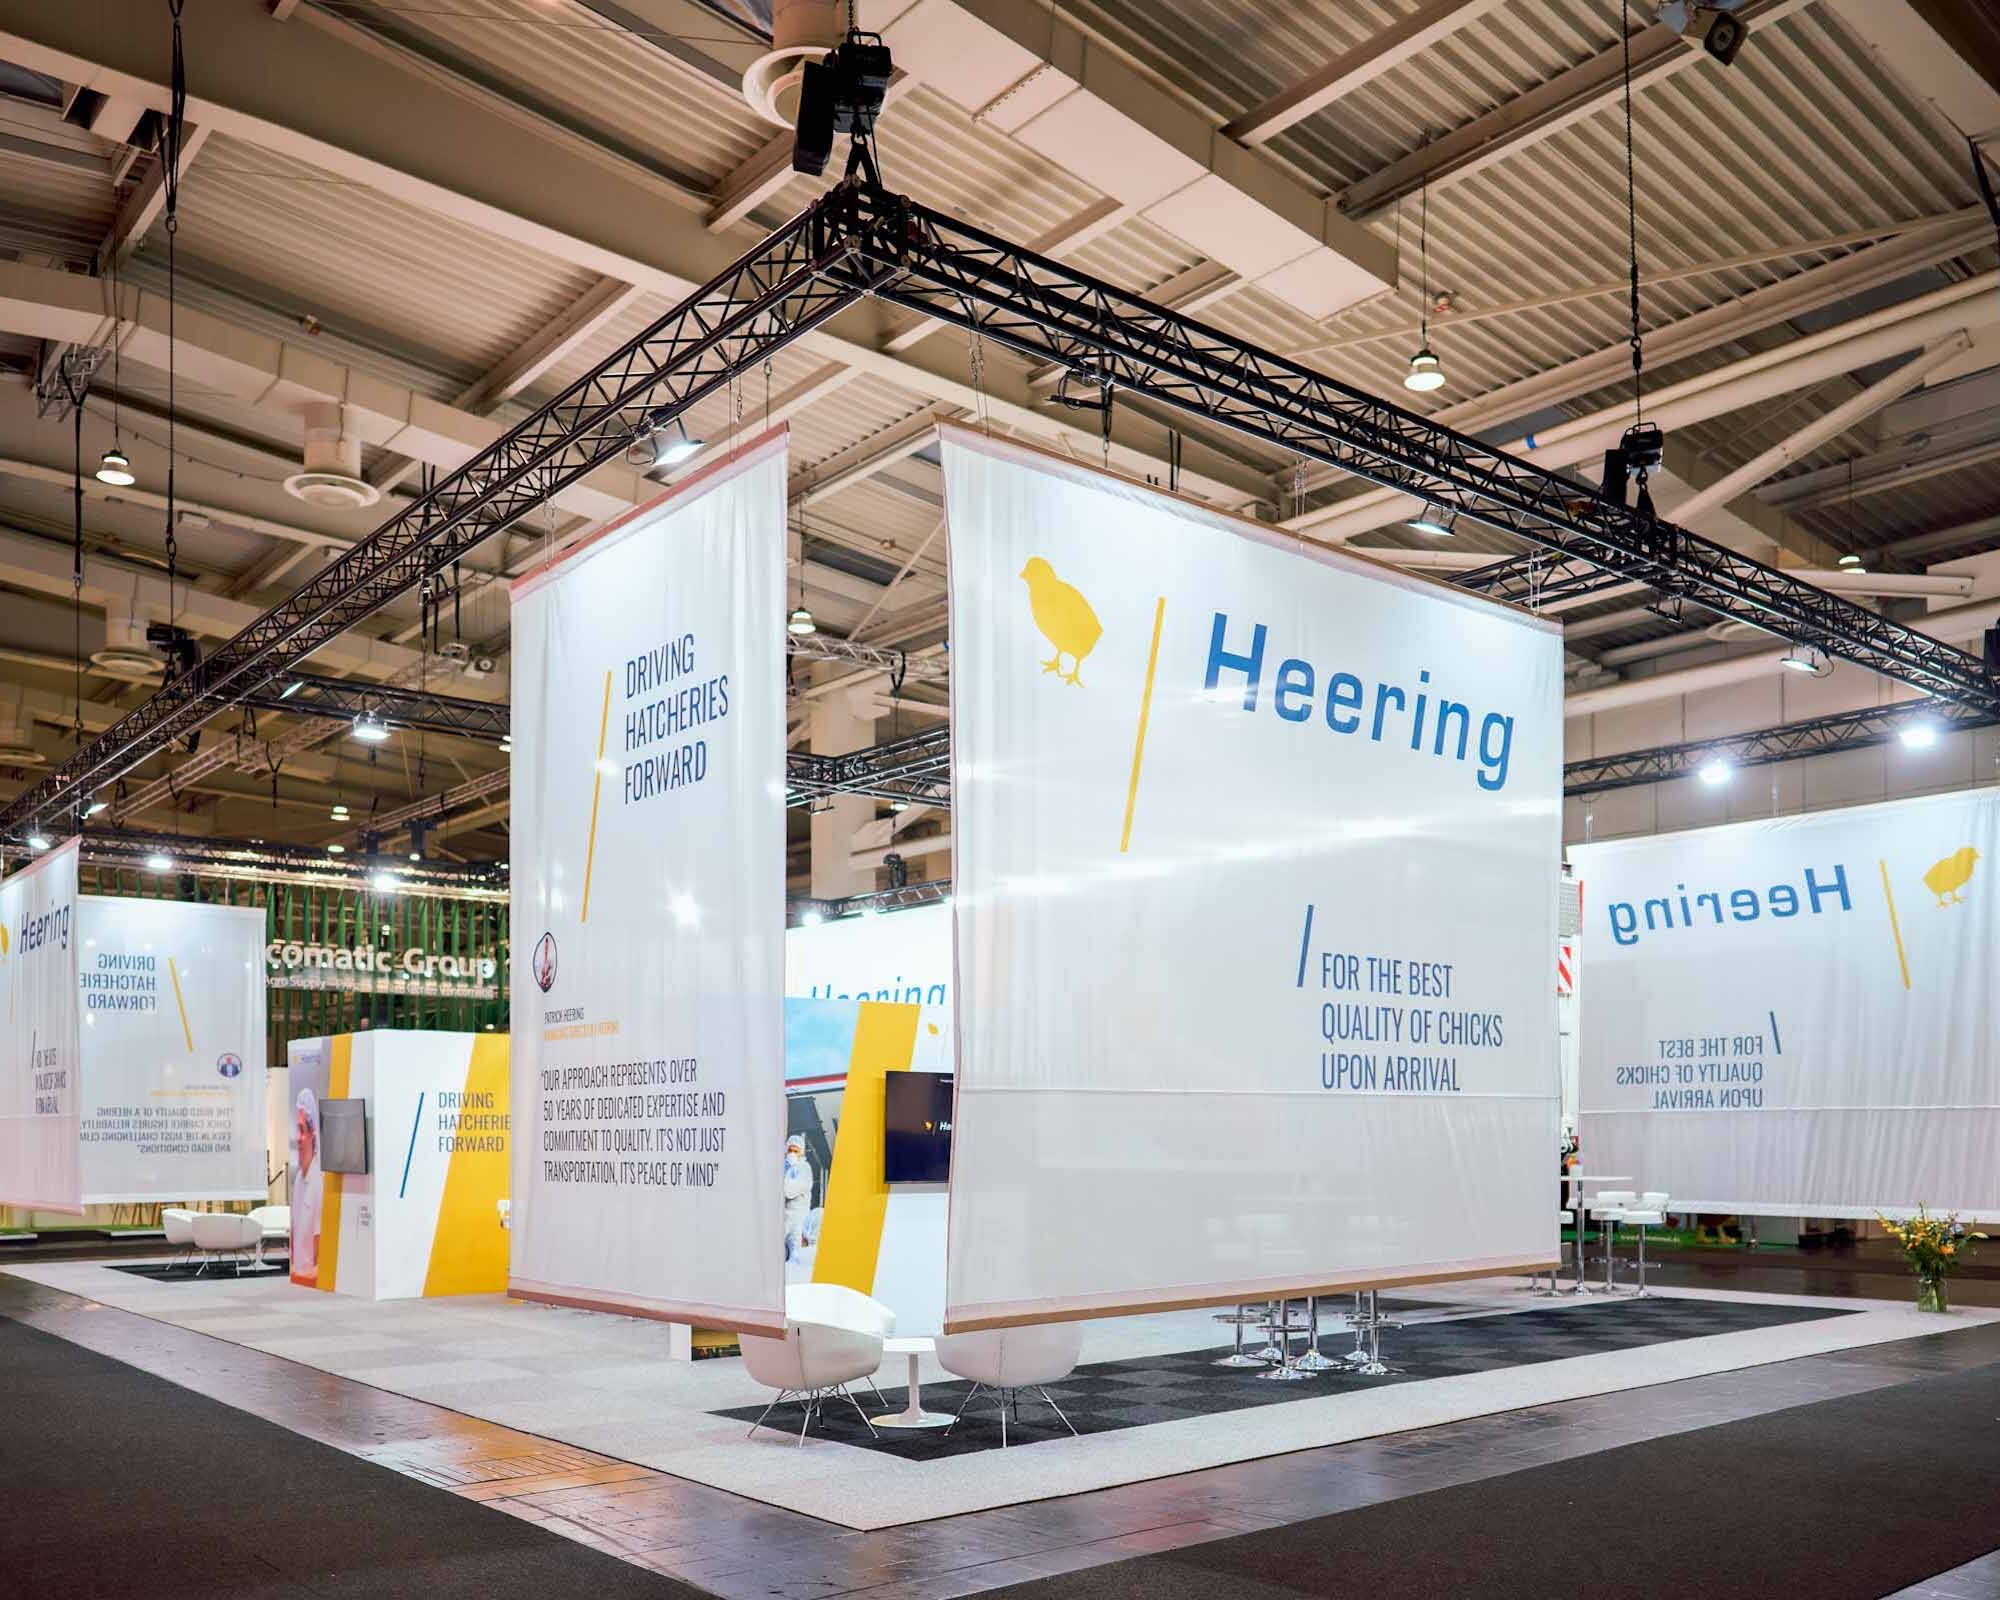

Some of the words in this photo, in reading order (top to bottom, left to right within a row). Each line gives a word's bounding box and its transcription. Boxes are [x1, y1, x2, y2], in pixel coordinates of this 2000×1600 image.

[627, 633, 694, 699] DRIVING
[626, 675, 728, 752] HATCHERIES
[1204, 612, 1514, 791] Heering
[625, 740, 706, 804] FORWARD
[19, 900, 70, 954] Heering
[403, 948, 496, 985] Group
[1322, 953, 1359, 991] FOR
[1367, 957, 1402, 994] THE
[1409, 961, 1453, 998] BEST
[1322, 1002, 1403, 1044] QUALITY
[1411, 1009, 1432, 1043] OF
[1439, 1011, 1503, 1047] CHICKS
[562, 1066, 607, 1090] APPROACH
[611, 1061, 666, 1087] REPRESENTS
[670, 1058, 697, 1083] OVER
[1322, 1053, 1376, 1090] UPON
[1384, 1056, 1460, 1091] ARRIVAL
[439, 1092, 494, 1108] DRIVING
[544, 1100, 553, 1121] 50
[555, 1099, 582, 1120] YEARS
[584, 1098, 595, 1120] OF
[598, 1096, 644, 1119] DEDICATED
[647, 1093, 699, 1118] EXPERTISE
[701, 1092, 725, 1117] AND
[438, 1114, 511, 1130] HATCHERIE
[439, 1136, 504, 1152] FORWARD
[543, 1130, 599, 1151] COMMITMENT
[601, 1130, 611, 1151] TO
[614, 1129, 653, 1154] QUALITY.
[656, 1129, 673, 1151] IT'S
[676, 1128, 697, 1151] NOT
[700, 1128, 726, 1152] JUST
[544, 1161, 618, 1184] TRANSPORTATION,
[620, 1162, 635, 1184] IT'S
[638, 1162, 667, 1185] PEACE
[671, 1163, 683, 1185] OF
